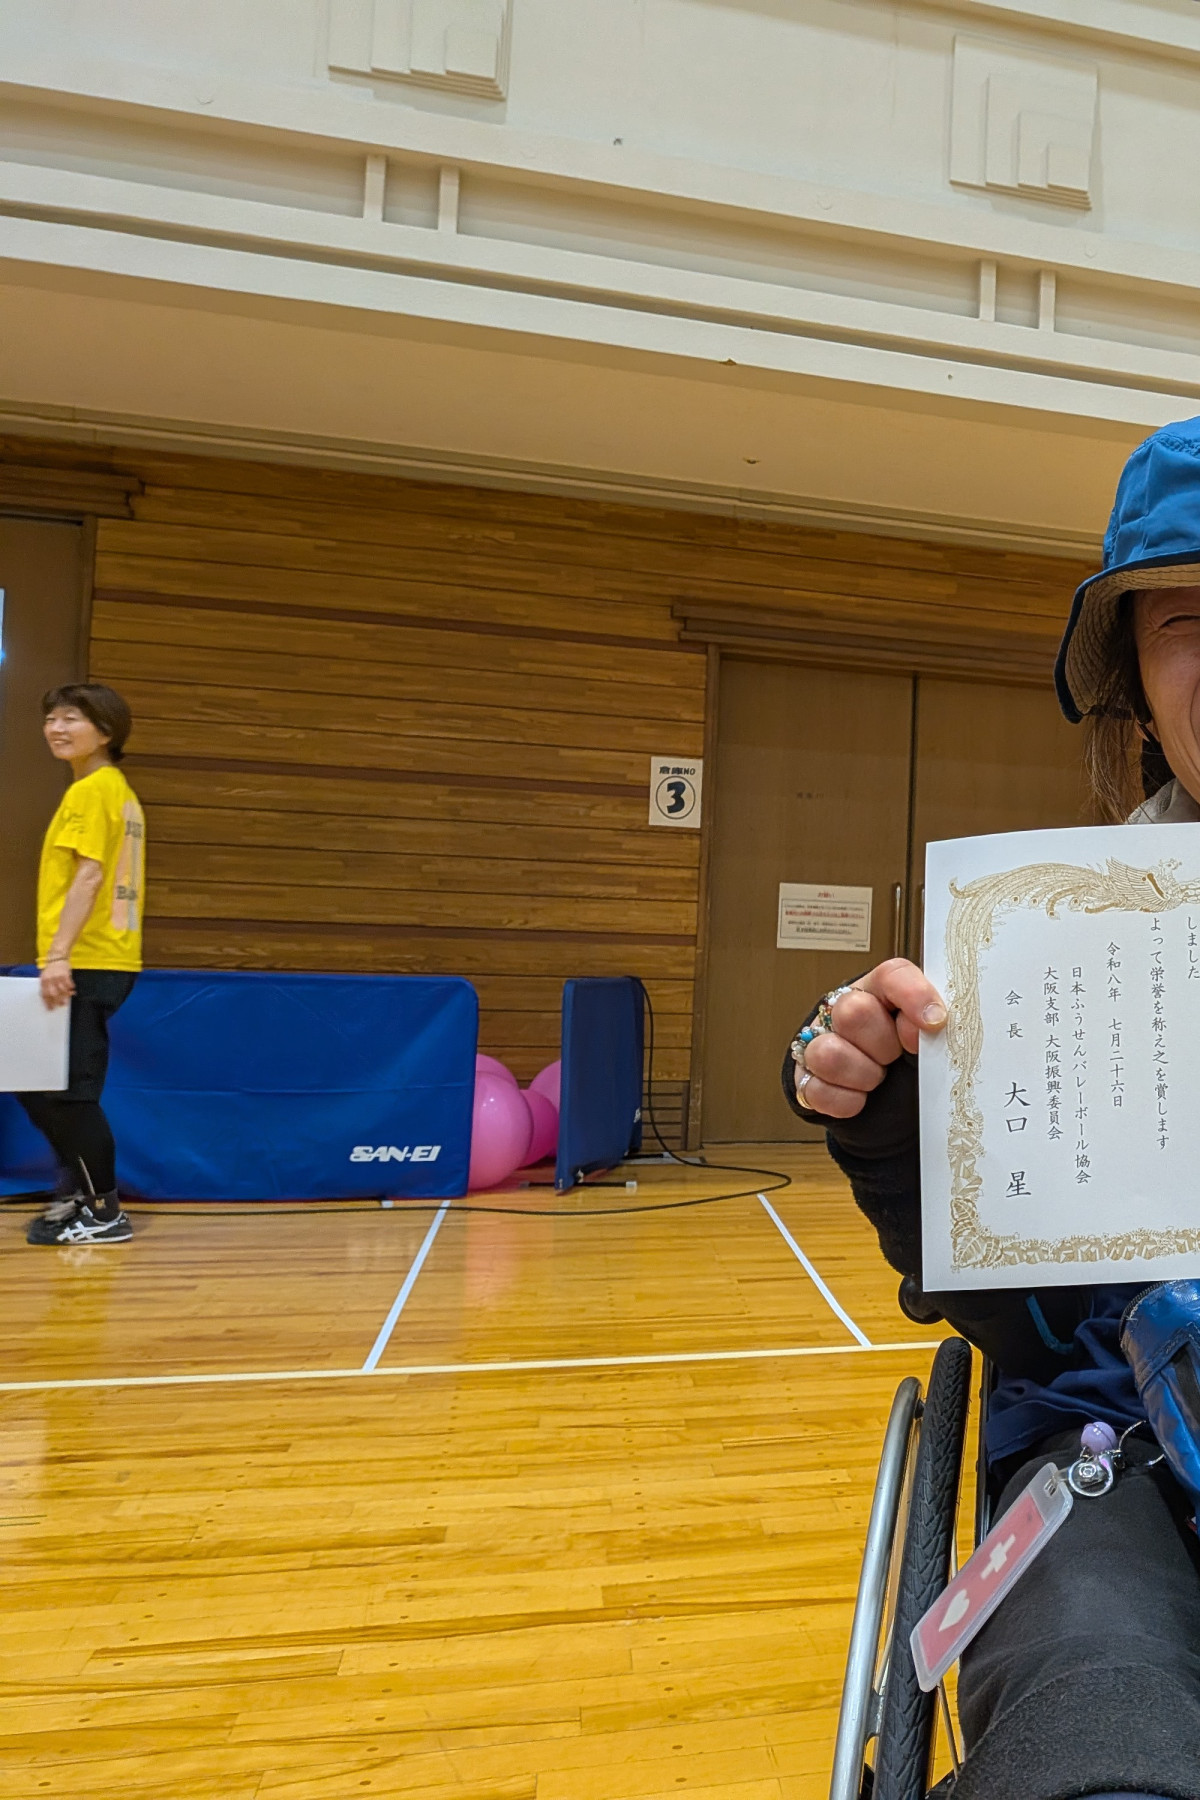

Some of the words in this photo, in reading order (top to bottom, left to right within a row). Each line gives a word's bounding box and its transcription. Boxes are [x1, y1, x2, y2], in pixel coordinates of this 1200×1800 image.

[666, 781, 686, 813] 3
[1106, 941, 1122, 1003] 令和八年
[1187, 916, 1200, 980] しました
[1043, 966, 1060, 1027] 大阪支部
[1108, 1018, 1125, 1108] 七月二十六日
[1149, 917, 1170, 1150] よって栄誉を称え之を賞します
[1044, 1034, 1064, 1141] 大阪振興委員会
[1069, 966, 1092, 1184] 日本ふうせんバレーボール協会
[1005, 1170, 1032, 1198] 星
